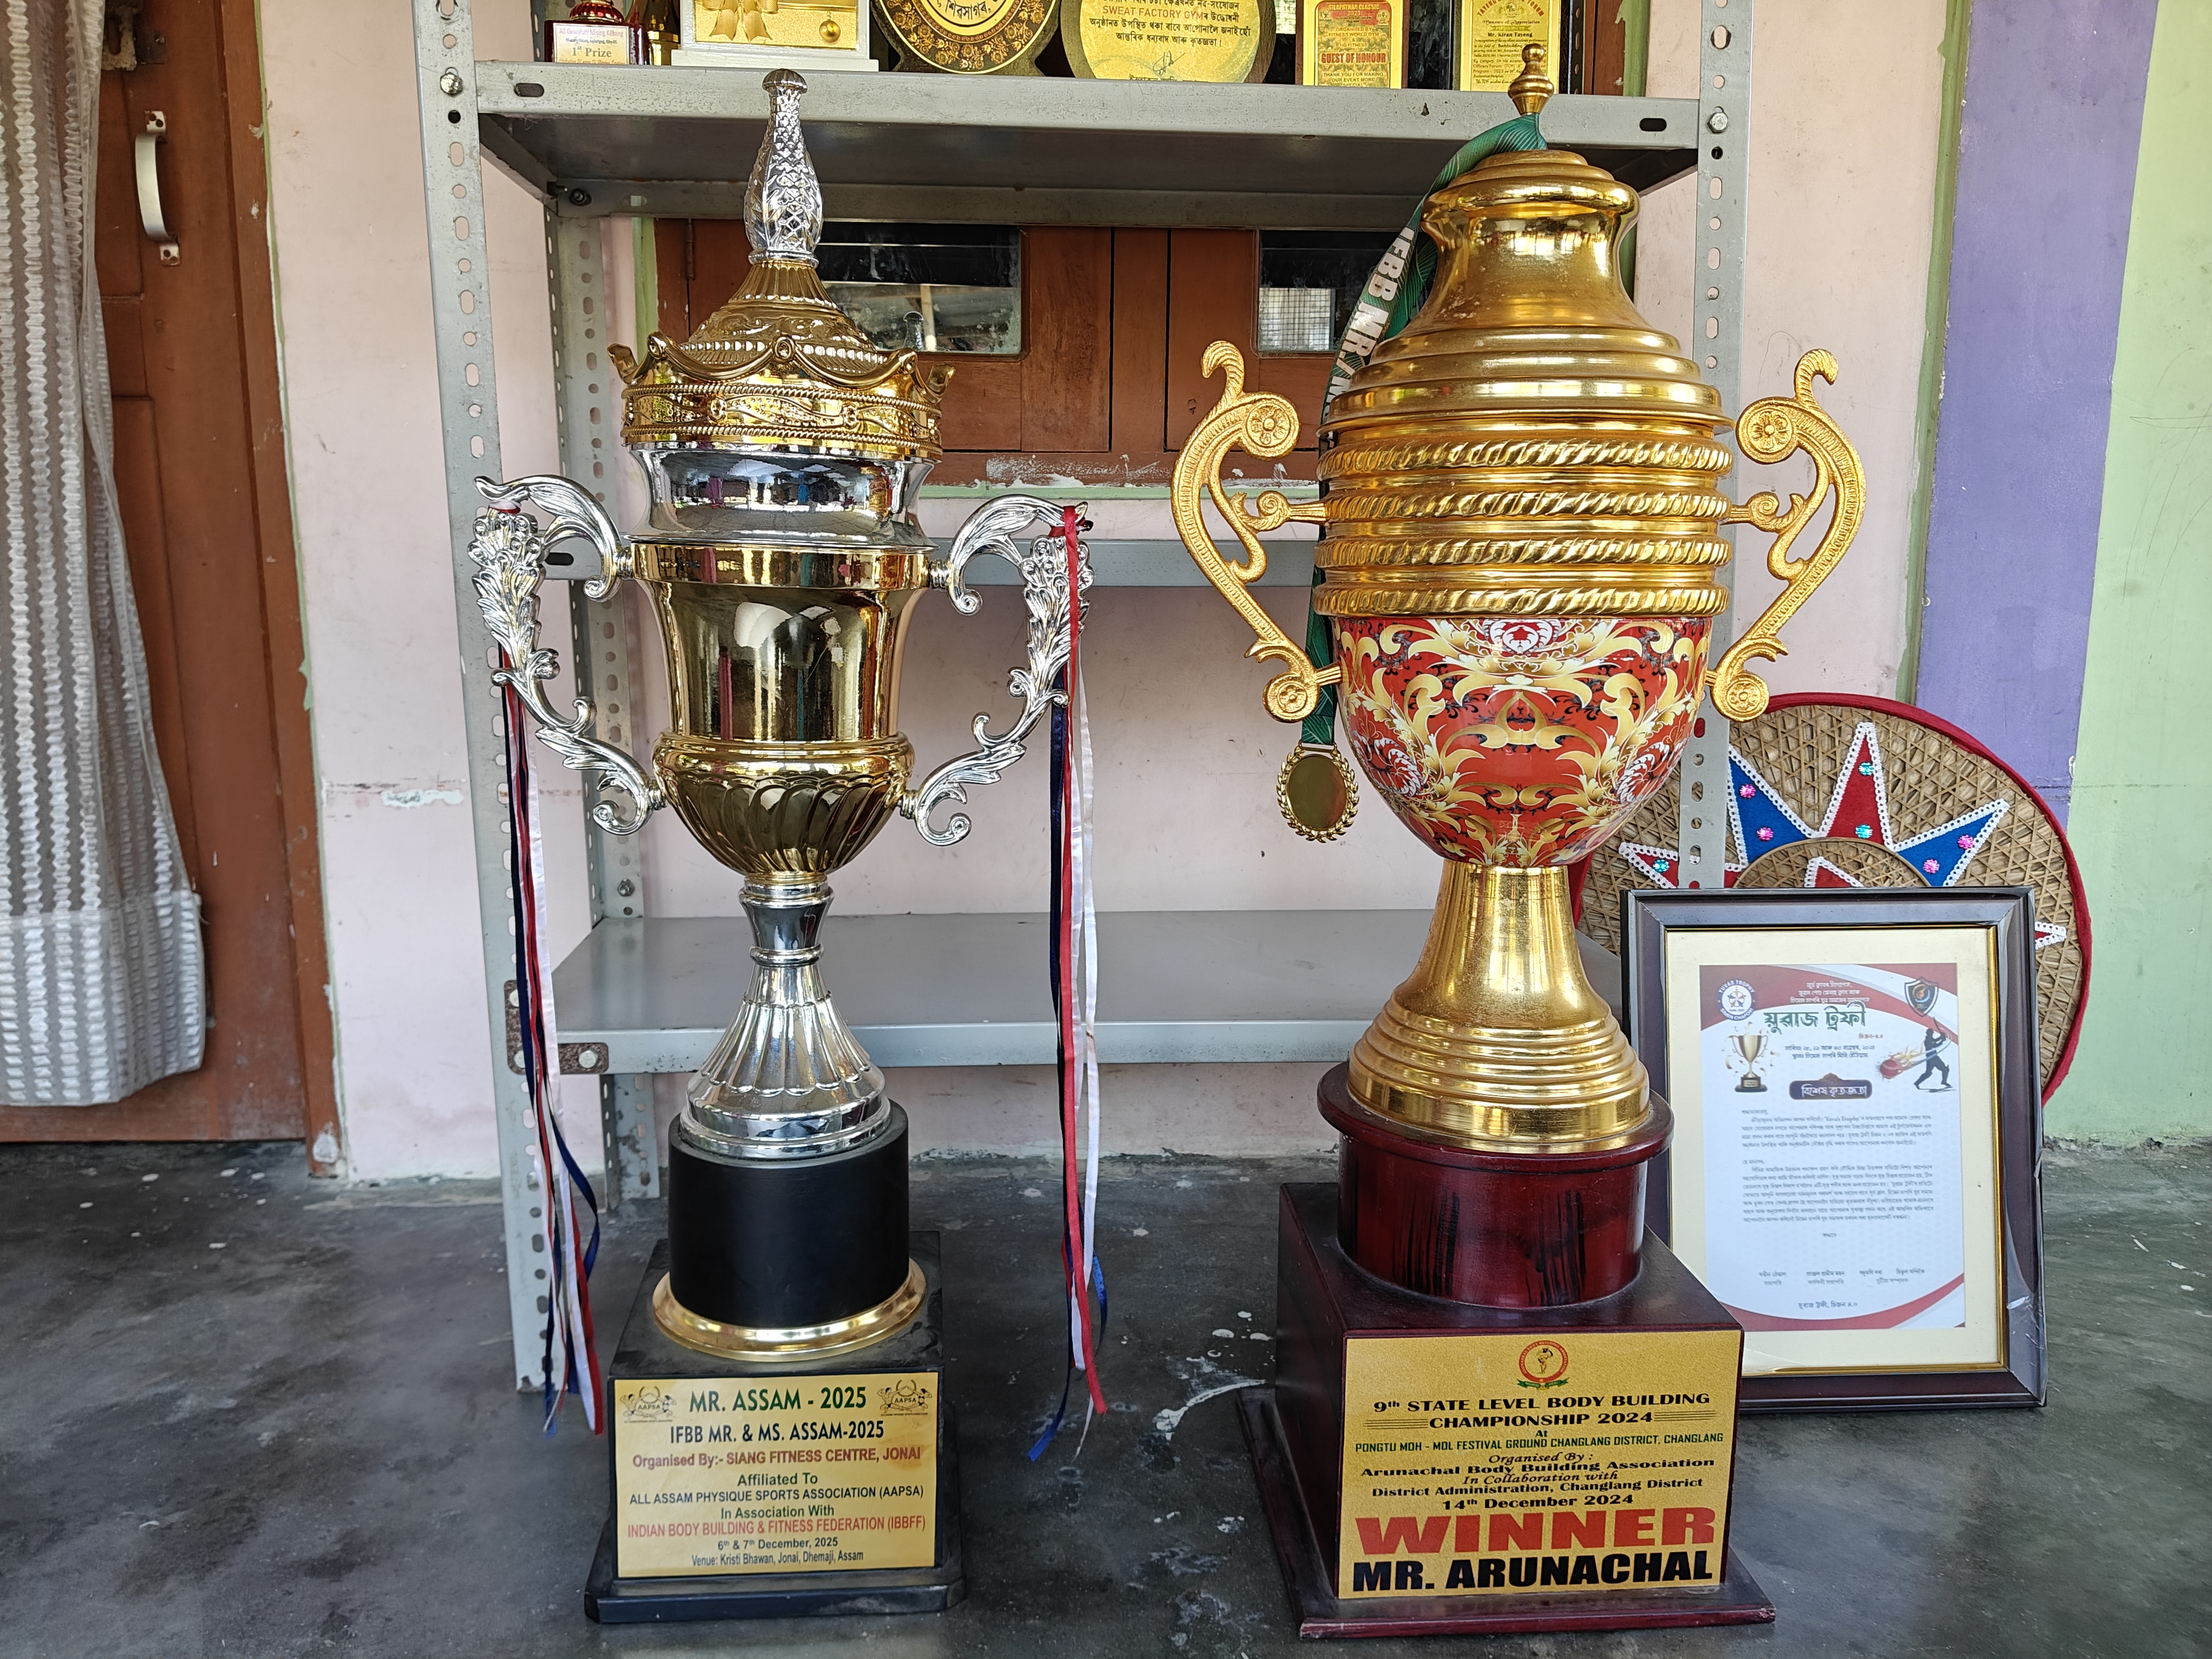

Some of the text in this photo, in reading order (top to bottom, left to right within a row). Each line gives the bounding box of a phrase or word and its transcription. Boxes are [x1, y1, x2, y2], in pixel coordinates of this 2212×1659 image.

[1103, 5, 1136, 16] SWEAT
[1139, 8, 1181, 18] FACTORY
[1527, 0, 1545, 17] FORUM
[572, 46, 612, 58] 1st Prize
[1321, 52, 1386, 64] GUEST OF HONOUR
[1368, 227, 1415, 301] IFBB
[1718, 980, 1755, 993] YUVAS TROPHY
[1800, 1083, 1867, 1098] বিশেষ কৃতজ্ঞতা
[689, 1390, 726, 1413] MR.
[732, 1387, 801, 1412] ASSAM
[820, 1386, 867, 1409] 2025
[1374, 1393, 1710, 1412] 9th STATE LEVEL BODY BUILDING
[1429, 1412, 1653, 1428] CHAMPIONSHIP 2024
[671, 1420, 884, 1444] IFBB MR. & MS. ASSAM-2025
[1535, 1429, 1548, 1438] At
[1355, 1442, 1397, 1452] PONGTU
[1400, 1442, 1422, 1452] MOH
[1433, 1441, 1453, 1451] MOL
[1456, 1440, 1502, 1450] FESTIVAL
[1506, 1439, 1547, 1448] GROUND
[1550, 1437, 1611, 1447] CHANGLANG
[1614, 1435, 1661, 1446] DISTRICT,
[1664, 1433, 1723, 1444] CHANGLANG
[632, 1453, 695, 1471] Organised
[726, 1451, 766, 1465] SIANG
[770, 1449, 822, 1464] FITNESS
[825, 1447, 880, 1463] CENTRE,
[882, 1446, 921, 1461] JONAI
[1488, 1452, 1585, 1465] Organised By
[1360, 1459, 1715, 1476] Arunachal Body Building Association
[737, 1472, 818, 1486] Affiliated To
[1462, 1471, 1618, 1485] In Collaboration with
[629, 1485, 924, 1505] ALL ASSAM PHYSIQUE SPORTS ASSOCIATION (AAPSA)
[1372, 1479, 1703, 1496] District Administration, Changlang District
[1442, 1494, 1634, 1510] 14th December 2024
[721, 1504, 835, 1519] In Association With
[628, 1515, 926, 1538] INDIAN BODY BUILDING & FITNESS FEDERATION (IBBFF)
[1355, 1507, 1715, 1555] WINNER
[718, 1537, 839, 1550] 6th & 7th December, 2025
[691, 1550, 864, 1567] Venue: Kristi Bhawan, Jonai, Dhemaji, Assam
[1352, 1551, 1713, 1593] MR. ARUNACHAL
